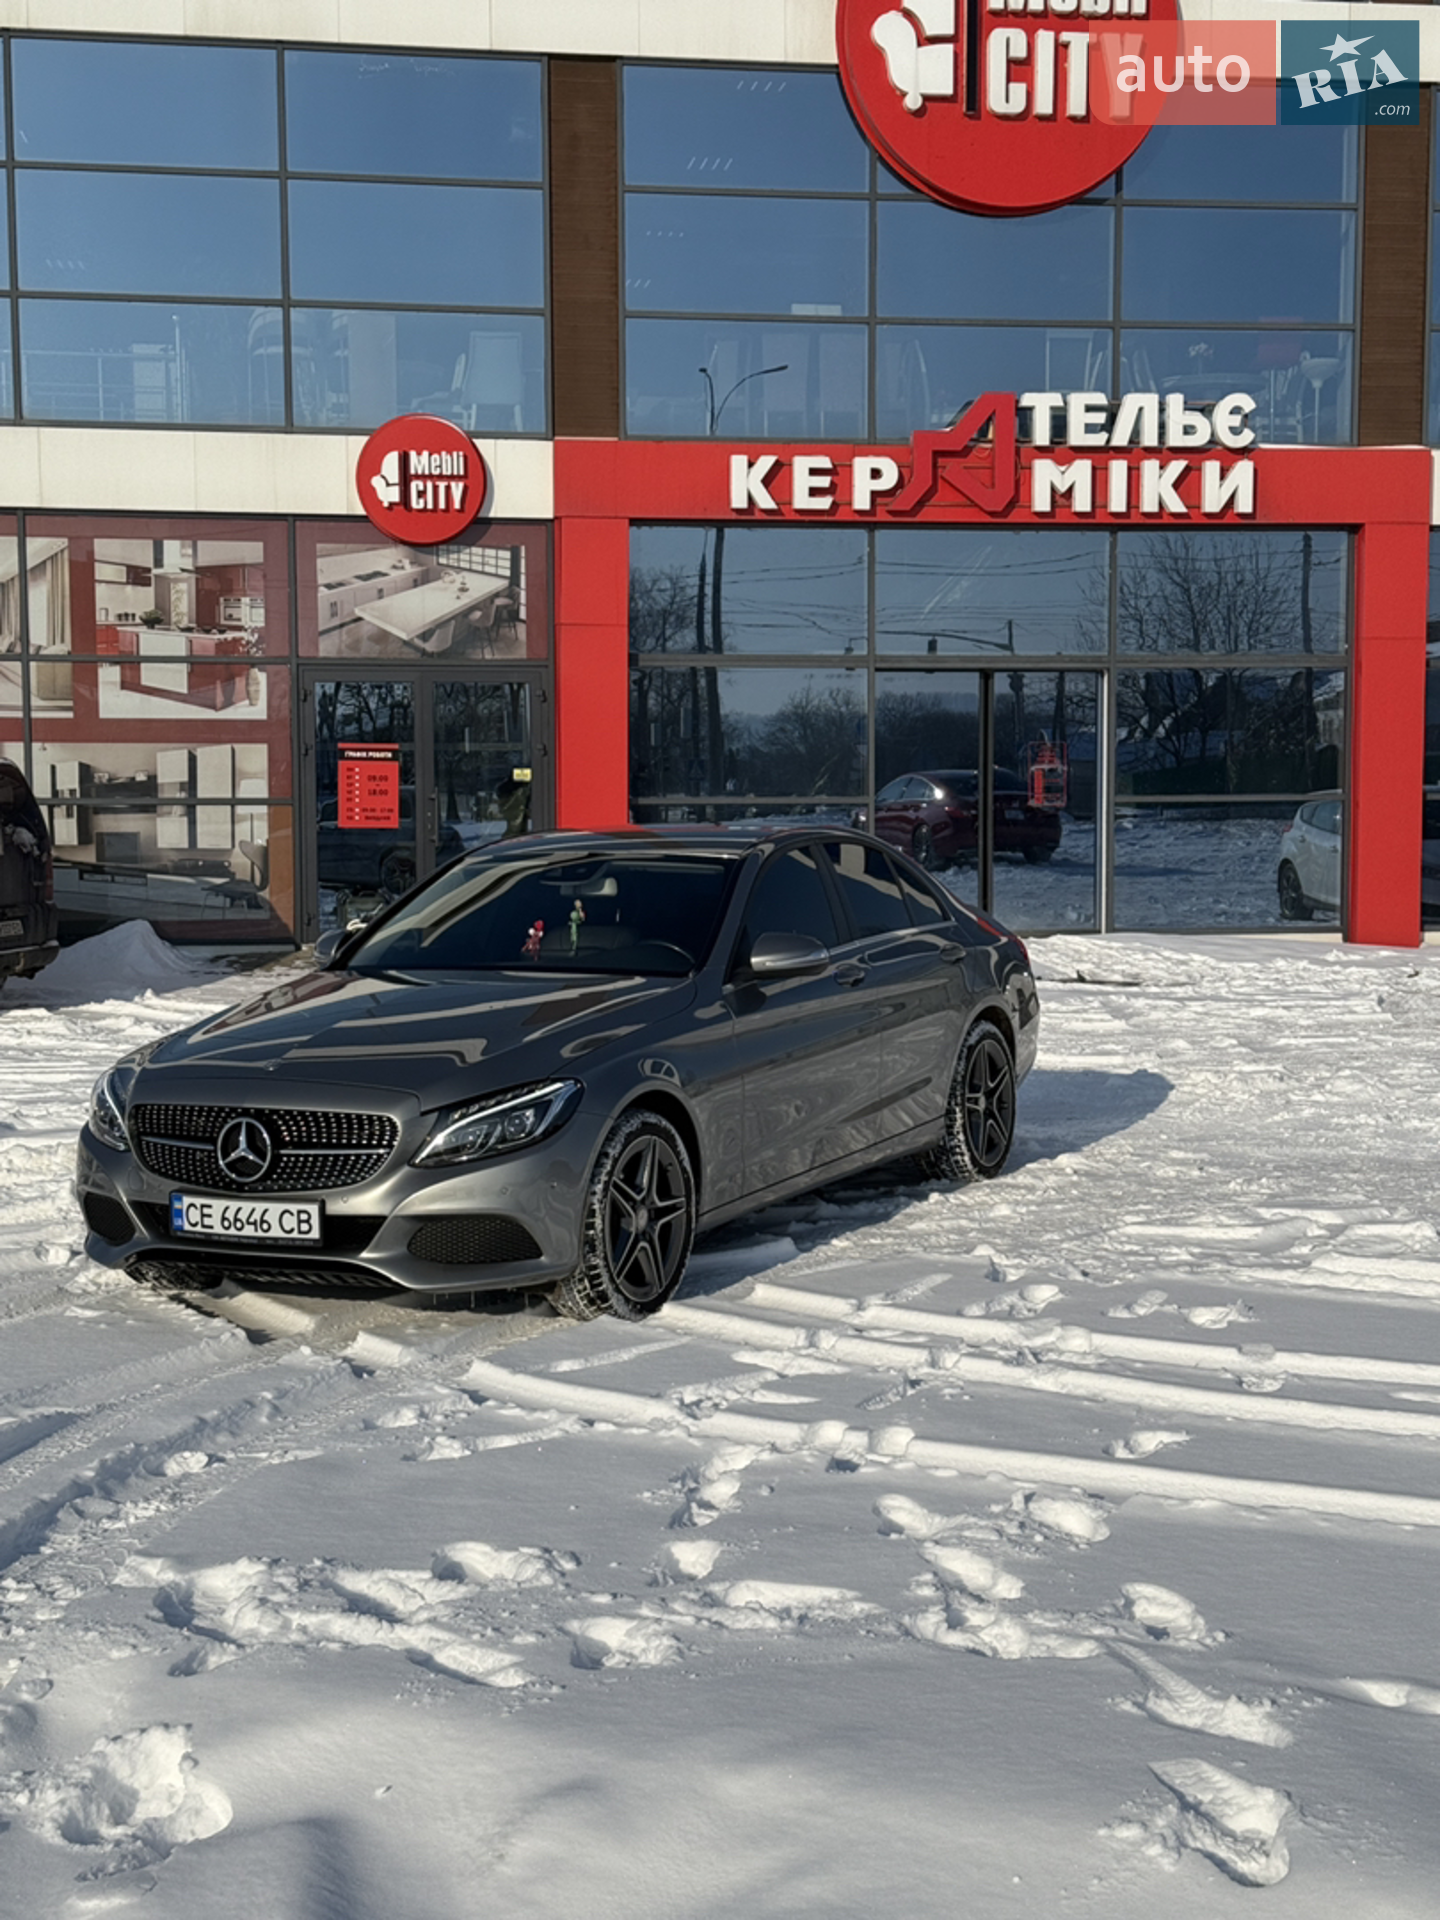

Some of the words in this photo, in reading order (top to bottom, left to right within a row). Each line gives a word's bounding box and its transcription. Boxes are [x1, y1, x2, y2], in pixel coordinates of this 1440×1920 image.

[986, 27, 1144, 119] CITY
[409, 450, 466, 476] Mebli
[410, 480, 466, 510] CITY
[185, 1202, 215, 1230] CE
[220, 1205, 272, 1234] 6646
[278, 1208, 313, 1236] CB
